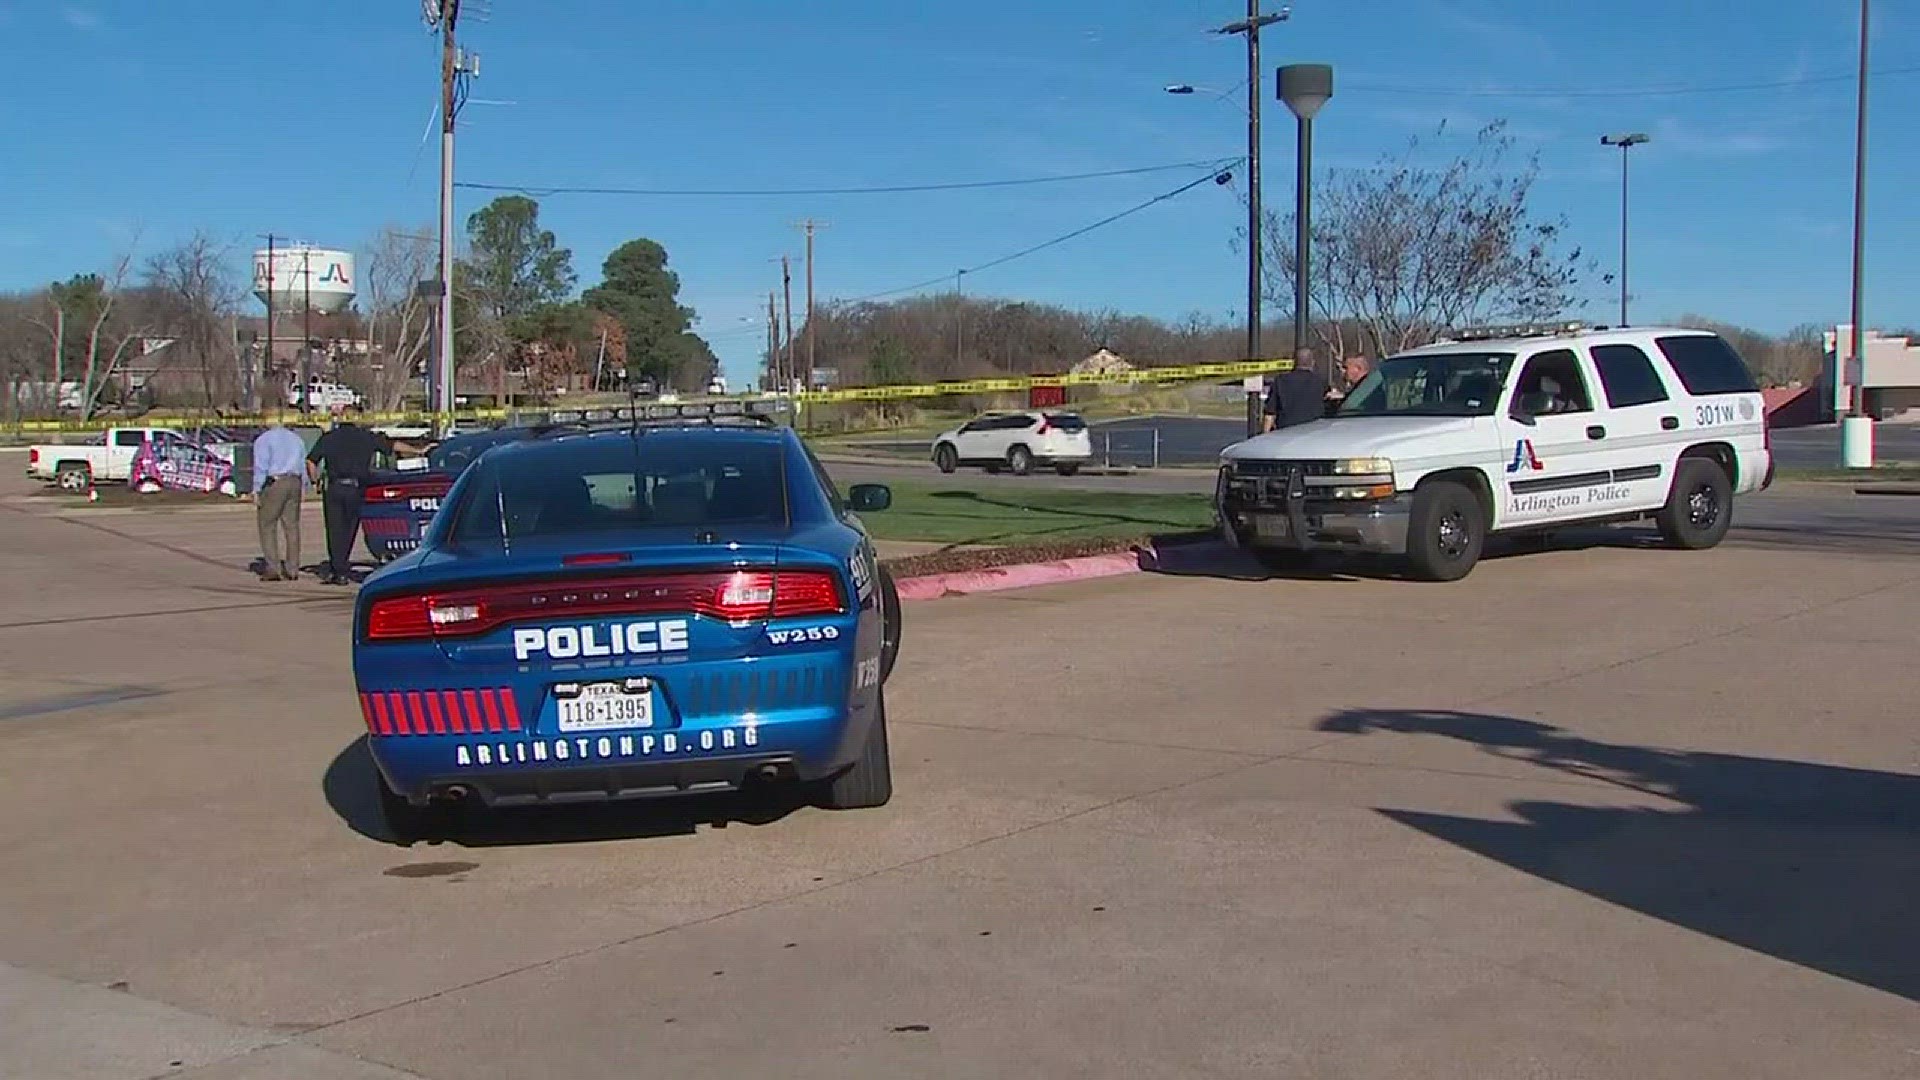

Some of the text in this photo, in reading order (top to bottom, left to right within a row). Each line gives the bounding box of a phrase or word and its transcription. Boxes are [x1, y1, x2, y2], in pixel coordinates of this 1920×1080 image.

[1695, 404, 1735, 426] 301W
[1508, 484, 1631, 513] Arlington Police
[513, 619, 689, 660] POLICE
[767, 625, 839, 645] W259
[456, 727, 759, 765] ARLINGTONPD.ORG
